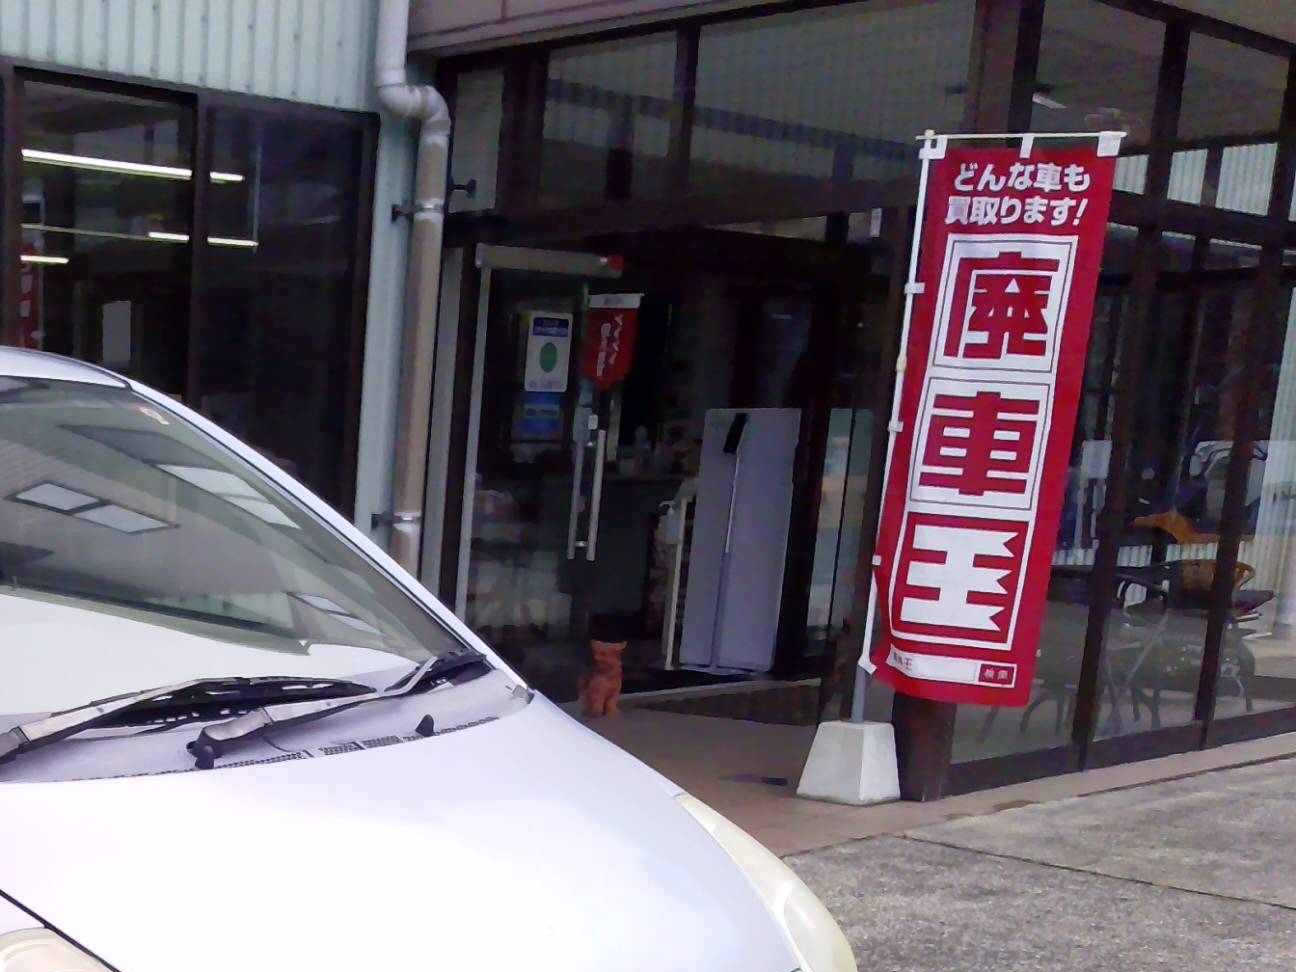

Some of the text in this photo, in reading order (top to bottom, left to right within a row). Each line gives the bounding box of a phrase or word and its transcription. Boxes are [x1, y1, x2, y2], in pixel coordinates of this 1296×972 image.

[953, 161, 1092, 193] どんな車も
[899, 251, 1062, 633] 廃車王
